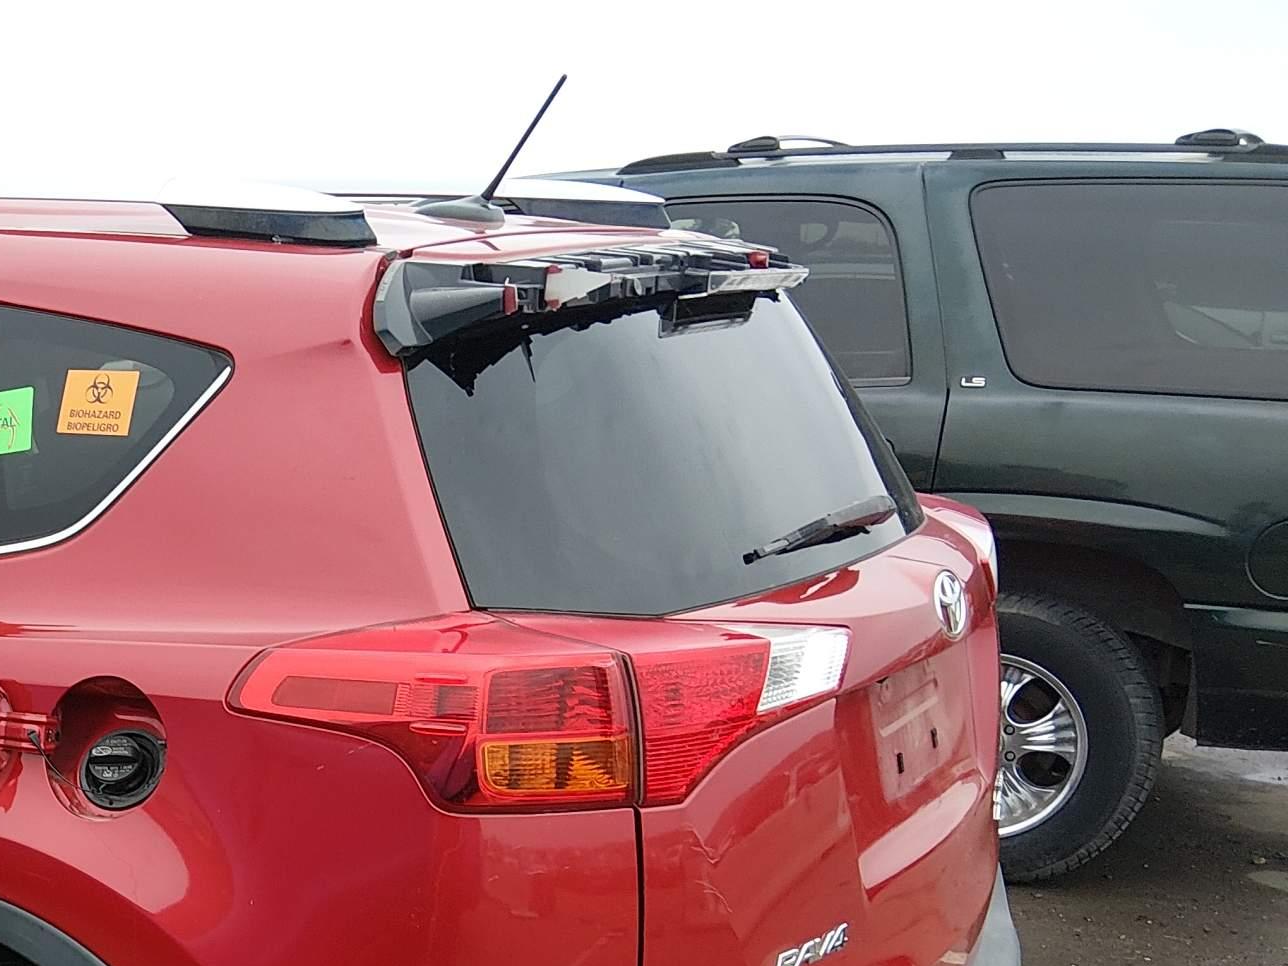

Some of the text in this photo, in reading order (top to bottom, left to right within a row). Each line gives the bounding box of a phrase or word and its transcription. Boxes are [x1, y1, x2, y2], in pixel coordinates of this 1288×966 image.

[961, 377, 986, 387] LS
[69, 409, 121, 420] BIOHAZARD
[66, 422, 119, 433] BIOPELIGRO
